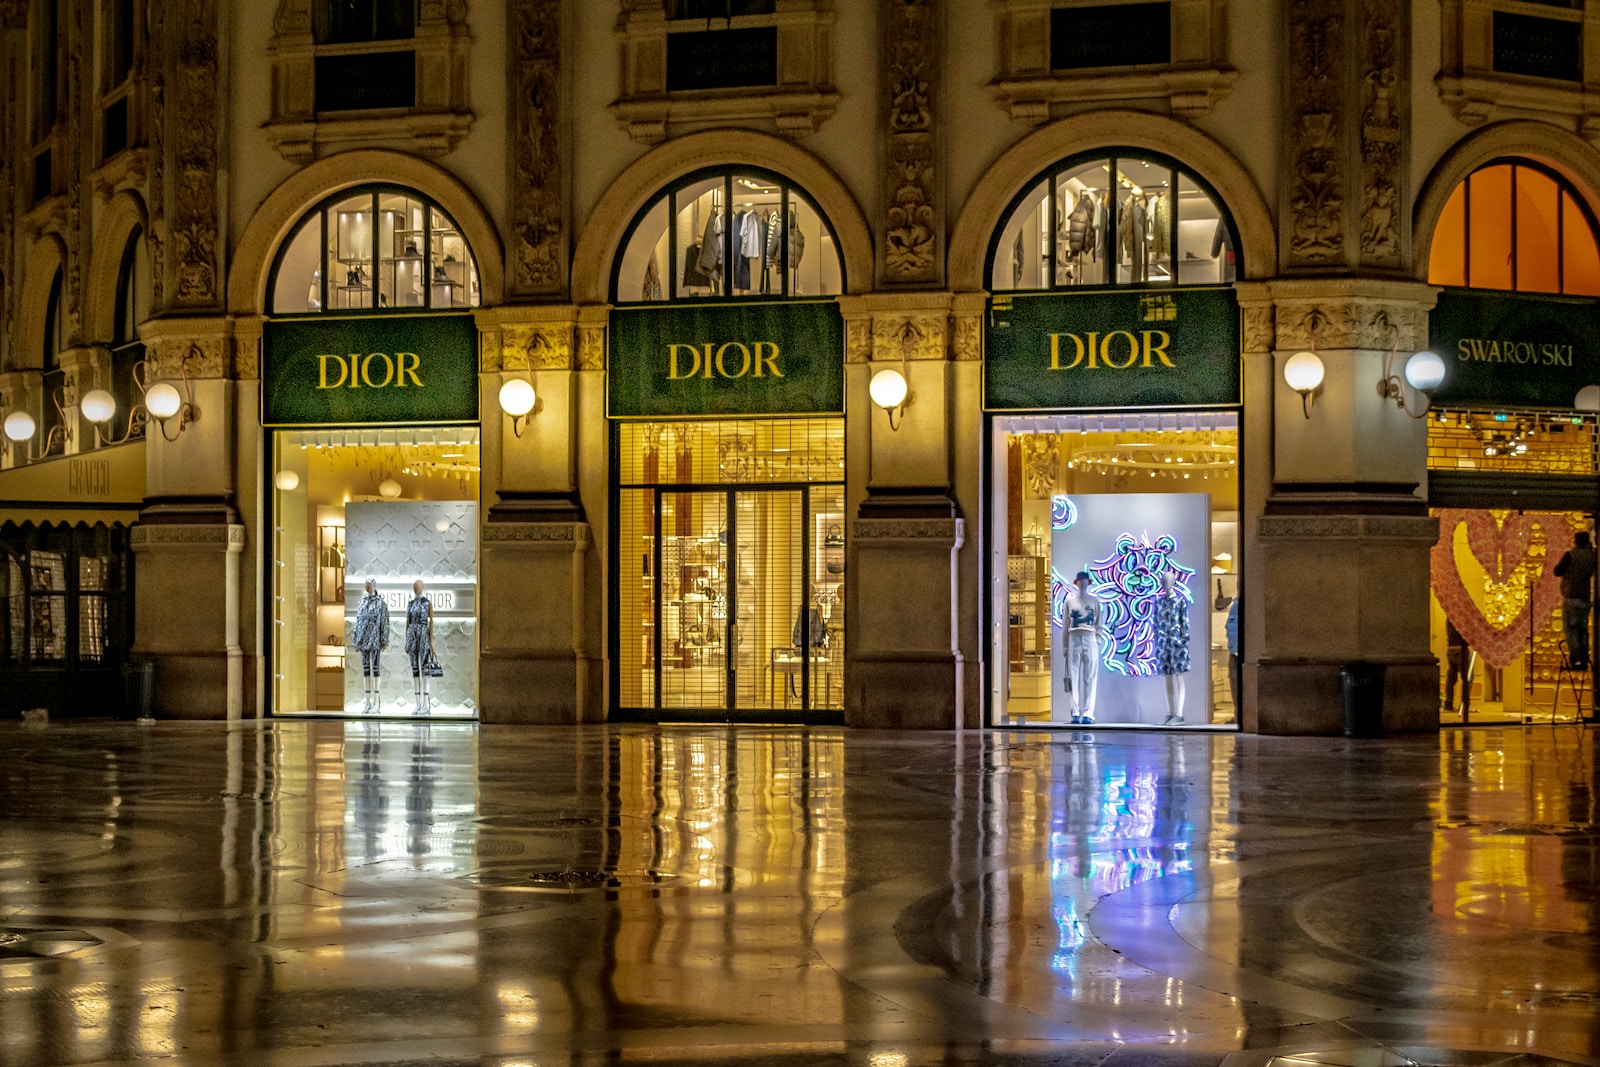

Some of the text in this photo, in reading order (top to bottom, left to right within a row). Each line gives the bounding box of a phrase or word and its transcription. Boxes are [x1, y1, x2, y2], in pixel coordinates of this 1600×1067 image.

[665, 341, 785, 379] DIOR
[1047, 330, 1176, 370] DIOR
[1457, 338, 1574, 367] SWAROVSKI
[316, 352, 425, 389] DIOR
